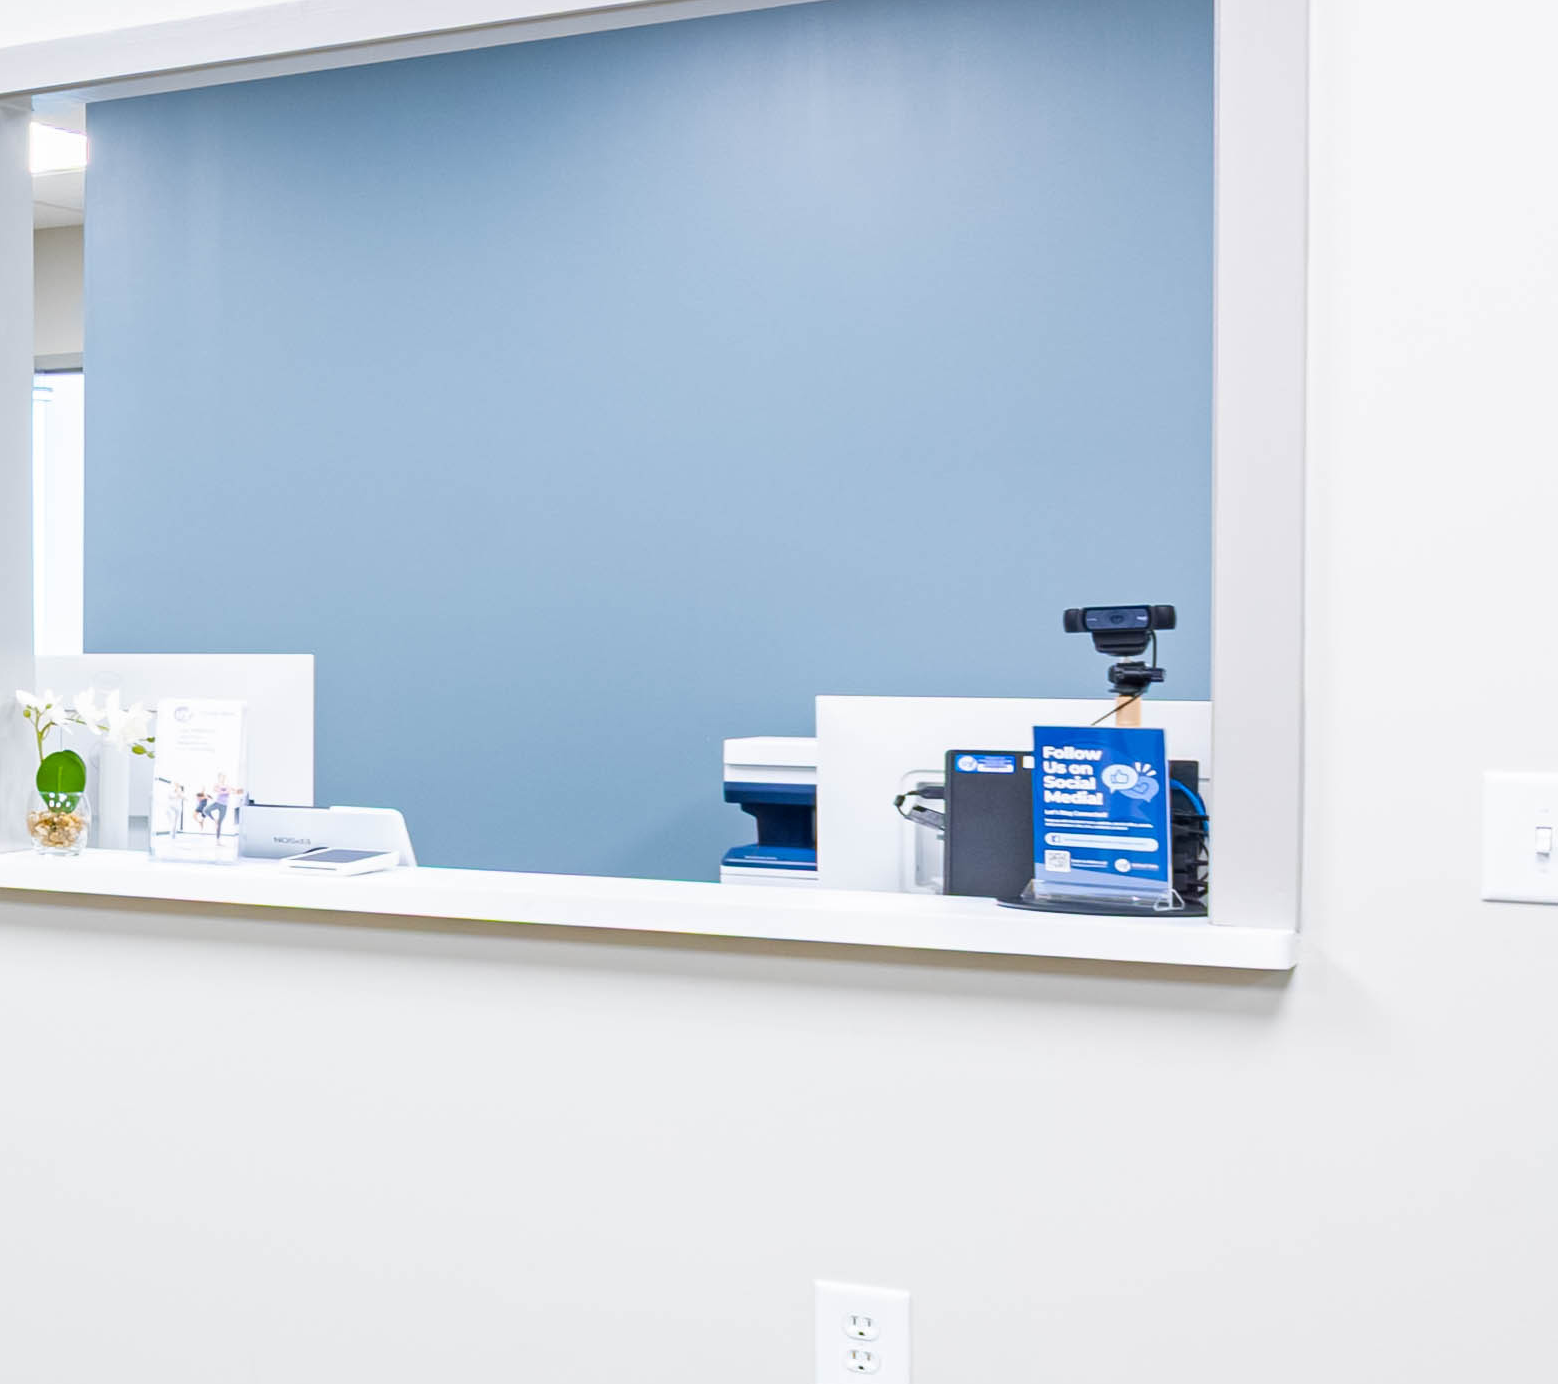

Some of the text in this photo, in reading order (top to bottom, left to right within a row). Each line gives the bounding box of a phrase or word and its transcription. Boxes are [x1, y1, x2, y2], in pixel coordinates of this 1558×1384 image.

[1042, 746, 1103, 761] Follow
[1042, 761, 1094, 775] Us on
[1043, 775, 1096, 790] Social
